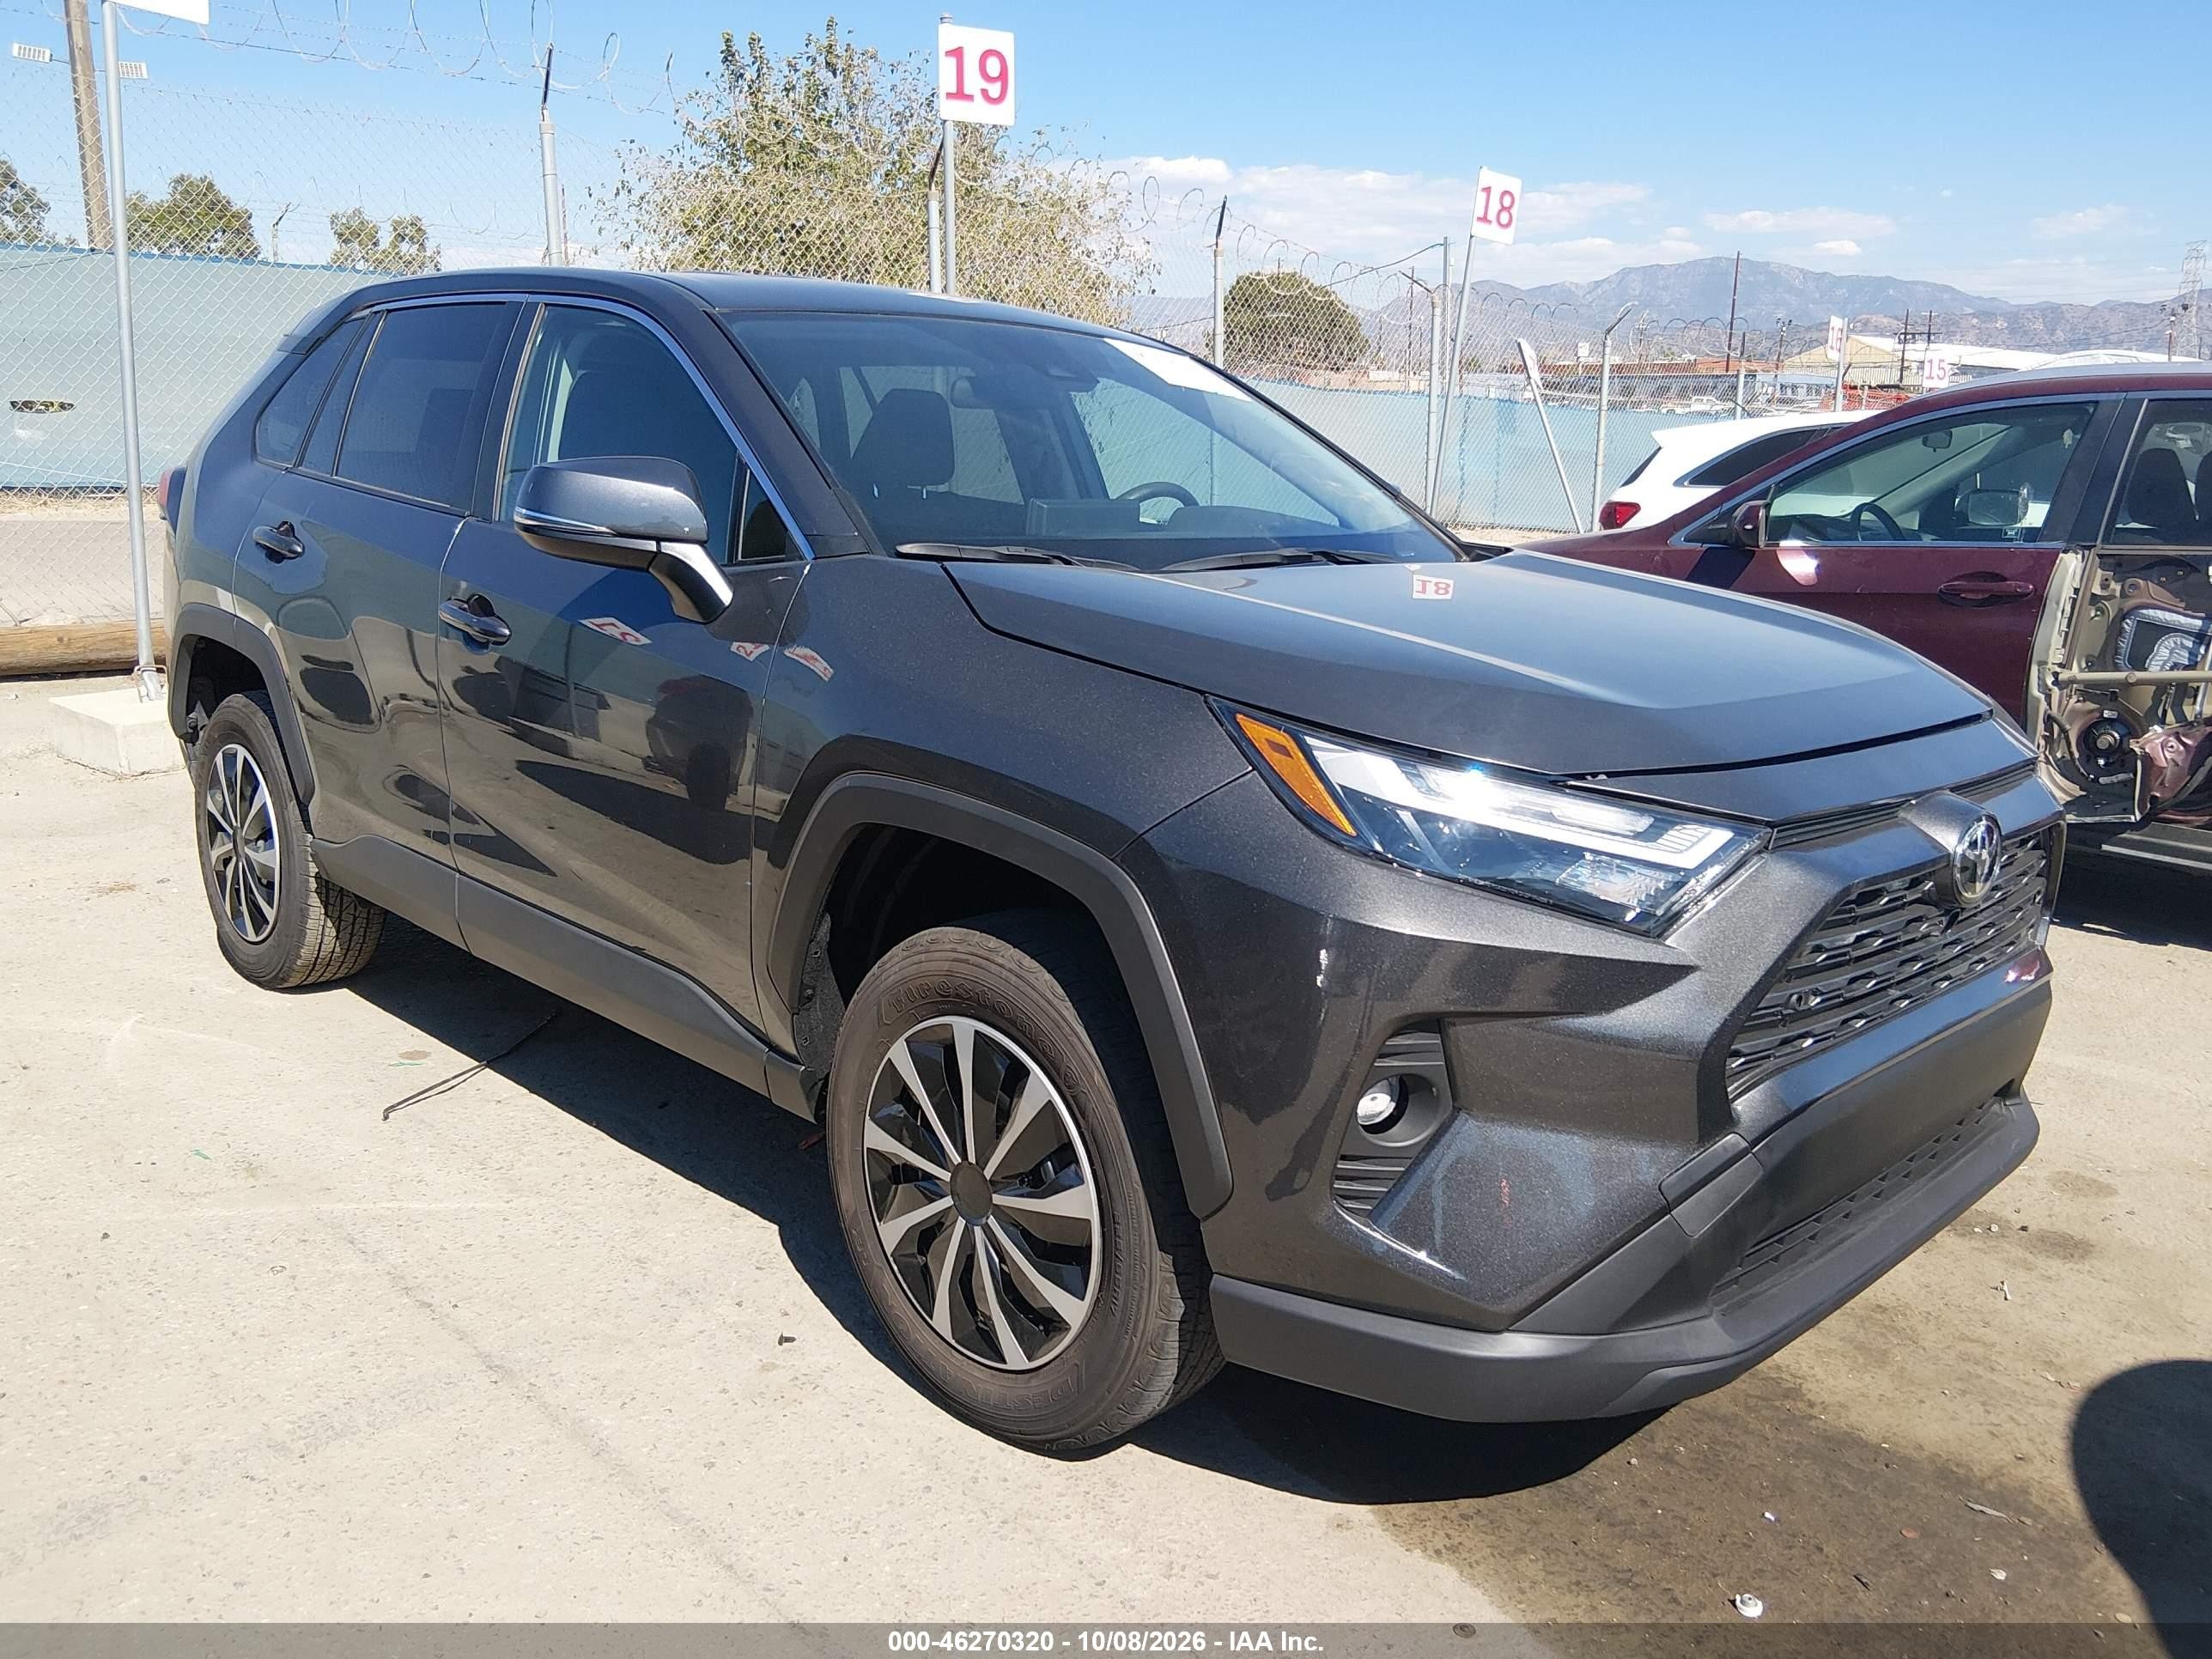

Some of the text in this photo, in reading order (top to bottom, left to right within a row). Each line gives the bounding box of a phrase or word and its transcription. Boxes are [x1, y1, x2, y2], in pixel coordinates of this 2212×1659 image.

[945, 46, 1008, 106] 19
[1477, 185, 1516, 229] 18
[1925, 359, 1947, 380] 15
[889, 979, 1054, 1058] Firestone
